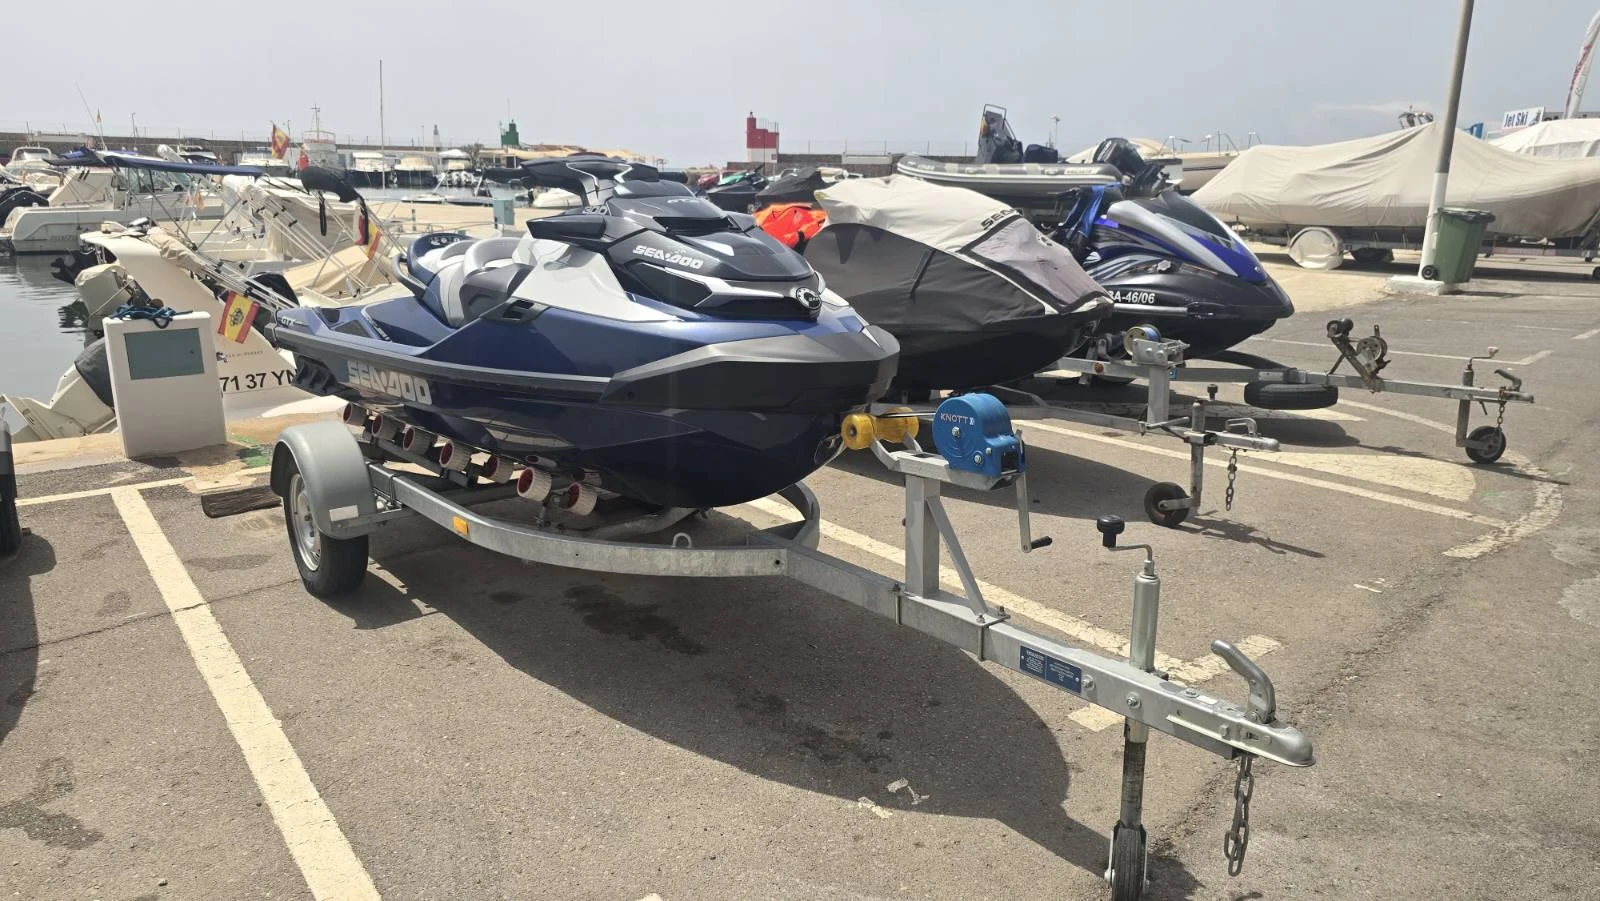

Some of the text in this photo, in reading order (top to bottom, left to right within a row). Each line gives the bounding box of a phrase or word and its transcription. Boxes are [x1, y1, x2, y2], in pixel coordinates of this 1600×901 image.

[1504, 111, 1528, 127] Jet Ski
[582, 206, 608, 215] 300
[219, 375, 240, 392] 71
[245, 372, 267, 389] 37
[940, 412, 968, 424] KNOTT
